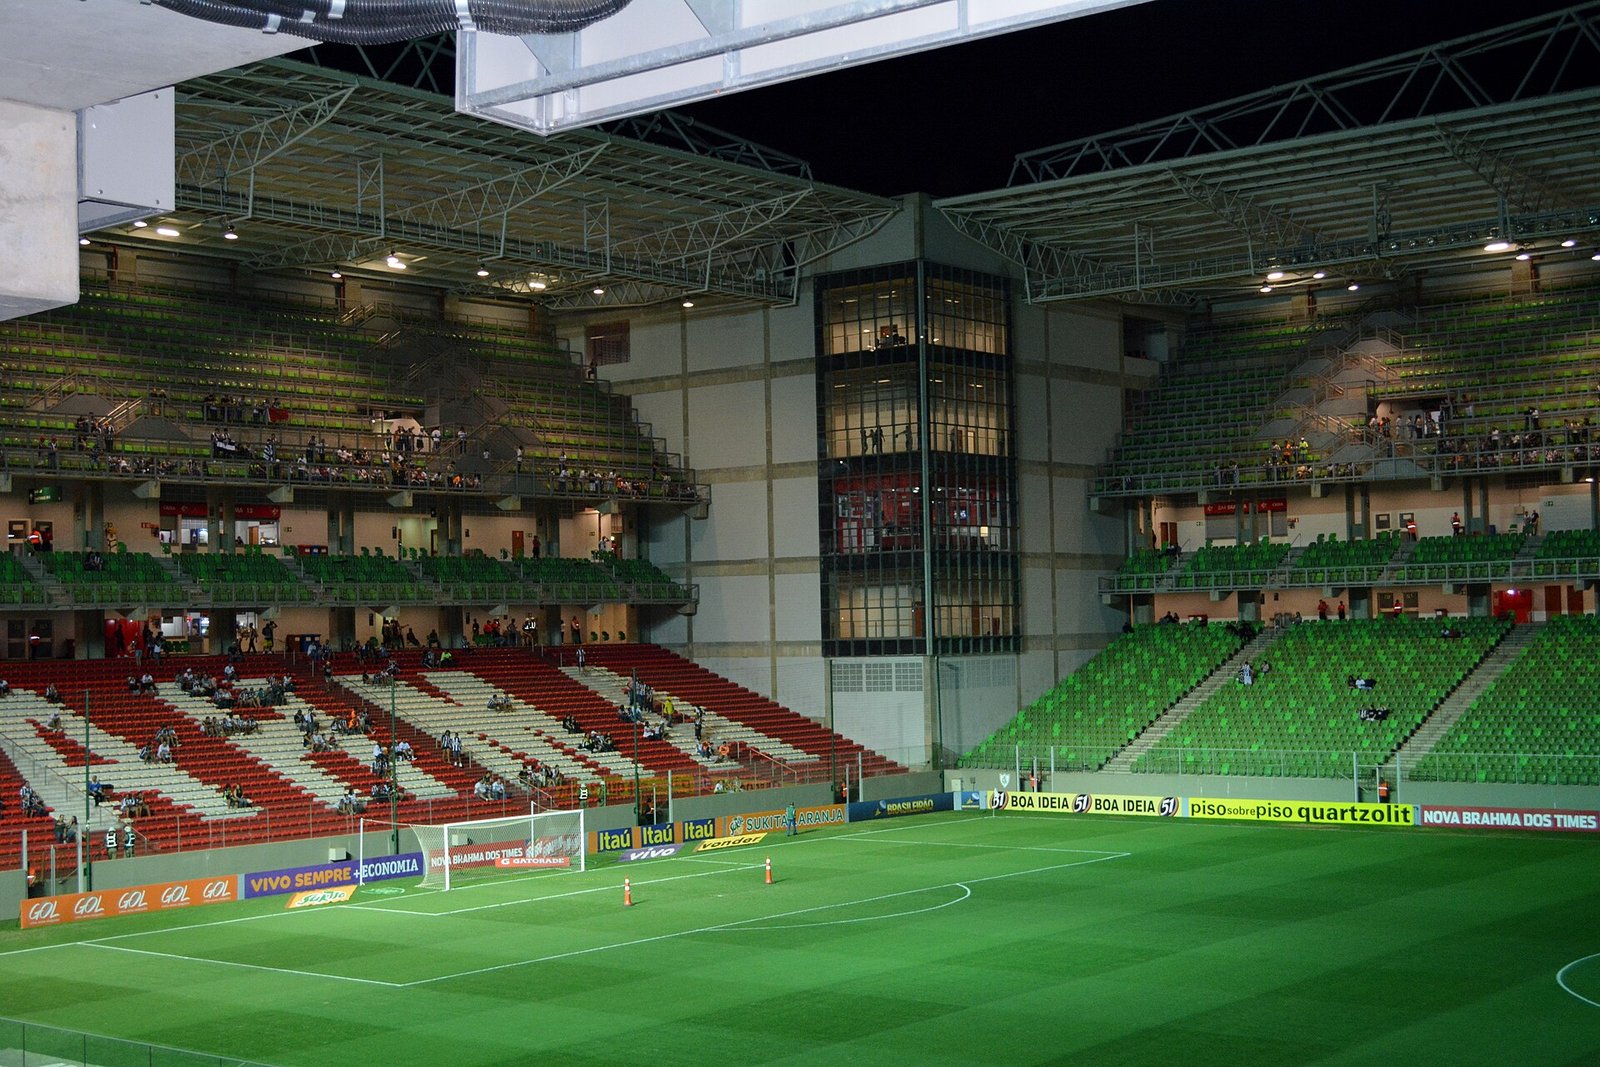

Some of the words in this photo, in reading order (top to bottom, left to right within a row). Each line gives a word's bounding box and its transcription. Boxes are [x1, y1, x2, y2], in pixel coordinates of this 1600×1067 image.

[1011, 795, 1035, 808] BOA
[1038, 797, 1069, 809] IDEIA
[1074, 794, 1088, 813] 51
[1095, 798, 1118, 811] BOA
[1123, 799, 1155, 813] IDEIA
[1161, 798, 1175, 815] 51
[1299, 805, 1410, 823] quartzolit
[746, 813, 788, 831] SUKITA
[795, 808, 844, 827] ARANJA
[1424, 810, 1460, 824] NOVA
[1462, 812, 1521, 826] BRAHMA
[1524, 814, 1552, 827] DOS
[1554, 815, 1597, 829] TIMES
[599, 829, 631, 851] Itaú
[643, 825, 673, 845] Itaú
[685, 820, 714, 840] Itaú
[702, 836, 760, 849] vonder
[453, 852, 484, 864] BRAHMA
[486, 850, 500, 860] DOS
[502, 848, 523, 857] TIMES
[630, 848, 675, 861] vivo
[203, 880, 231, 899] GOL
[251, 875, 291, 892] VIVO
[295, 867, 352, 887] SEMPRE
[118, 889, 148, 910] GOL
[161, 885, 191, 905] GOL
[29, 901, 60, 920] GOL
[74, 895, 104, 916] GOL
